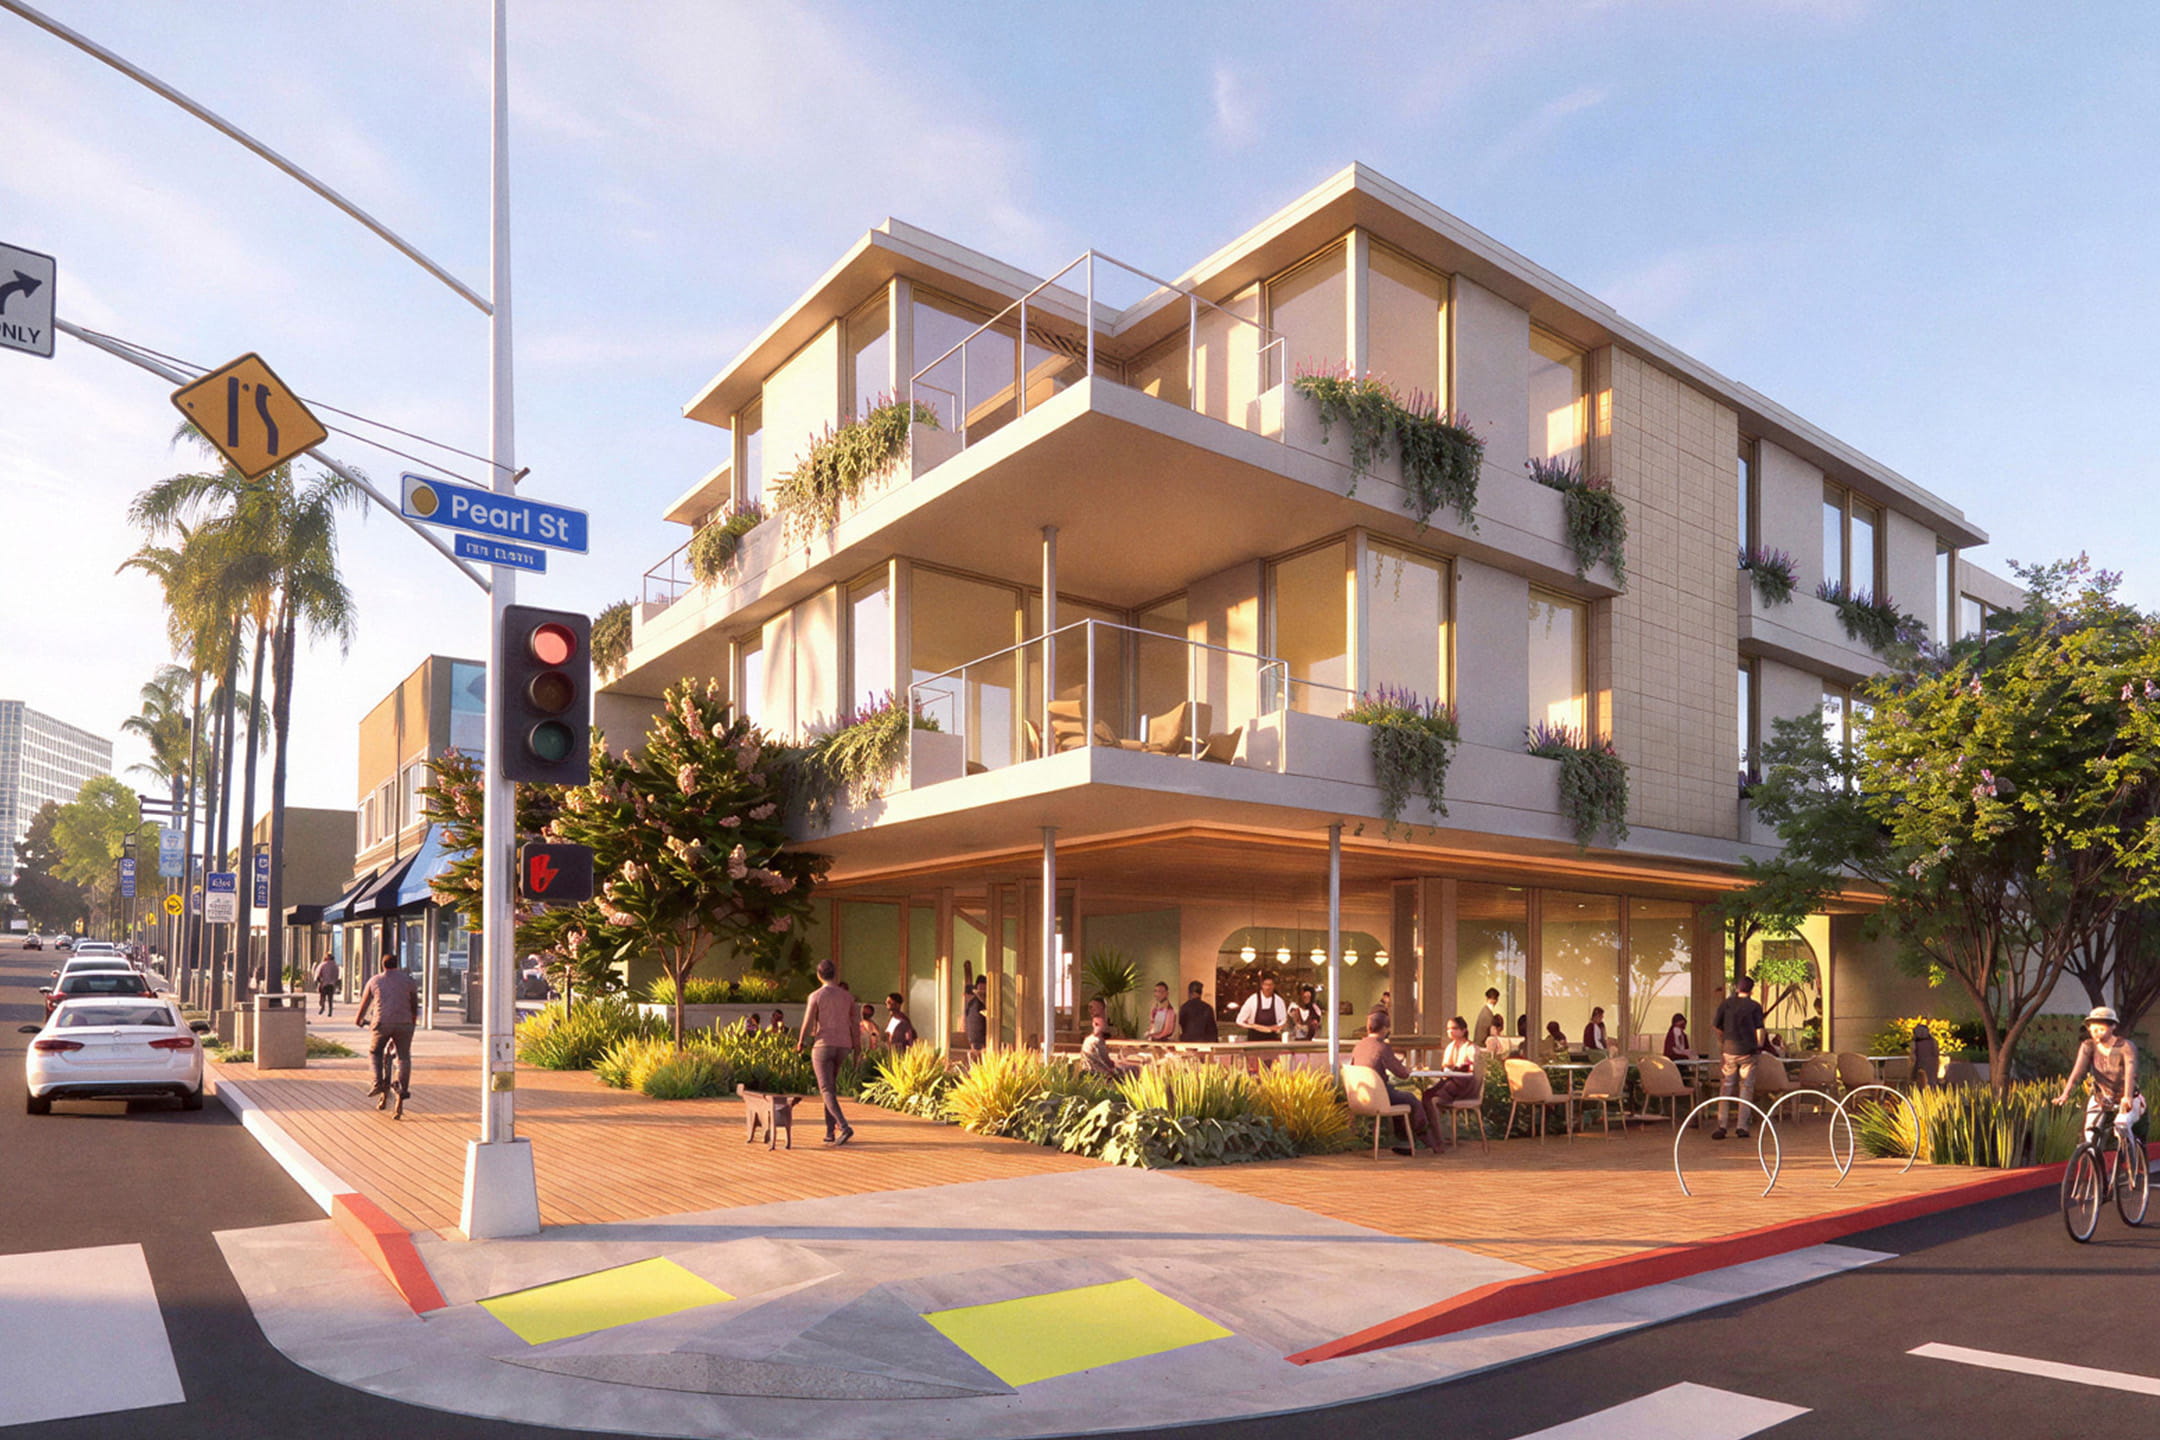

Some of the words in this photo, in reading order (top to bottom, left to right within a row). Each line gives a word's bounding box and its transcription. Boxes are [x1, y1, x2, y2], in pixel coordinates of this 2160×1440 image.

[0, 321, 41, 344] NLY
[451, 494, 530, 534] Pearl
[538, 513, 569, 542] St
